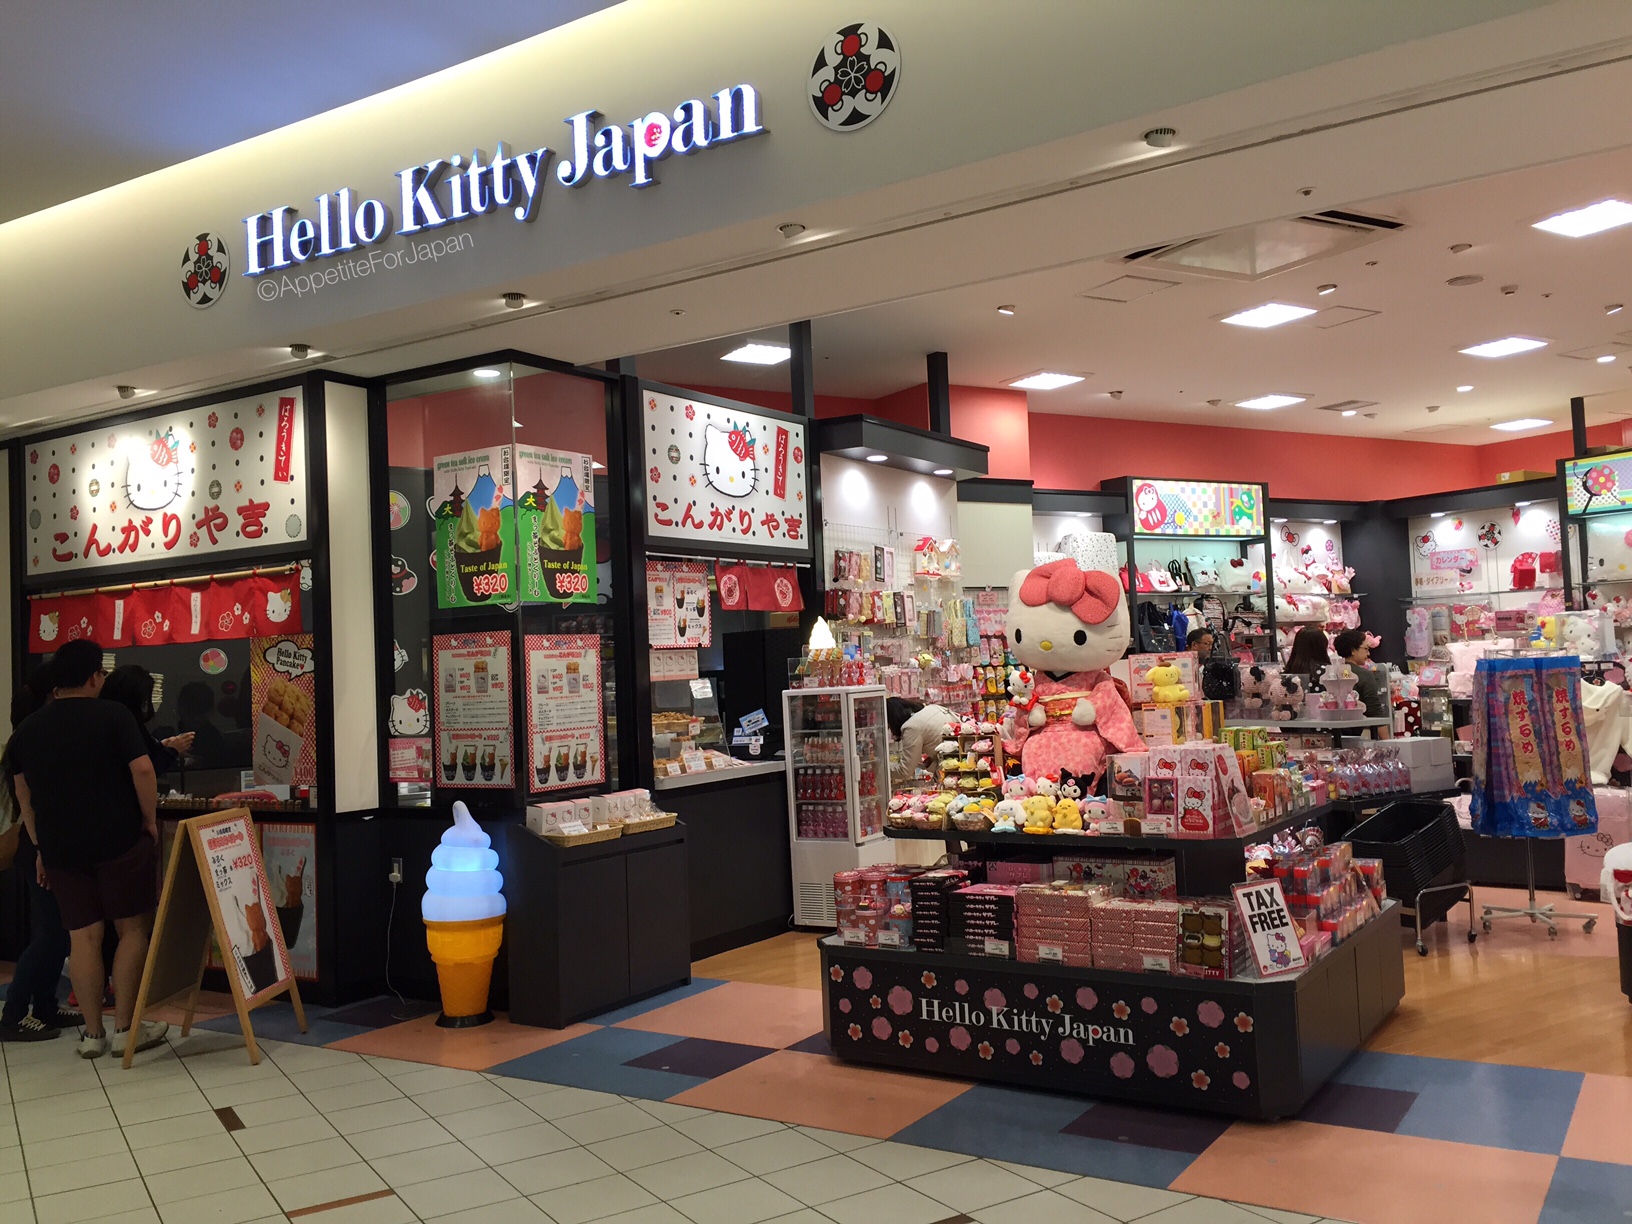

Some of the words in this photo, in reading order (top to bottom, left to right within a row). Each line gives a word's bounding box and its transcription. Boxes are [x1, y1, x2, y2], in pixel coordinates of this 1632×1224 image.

[242, 187, 390, 277] Hello
[394, 141, 554, 236] Kitty
[557, 83, 768, 189] Japan
[442, 504, 452, 516] 大
[524, 495, 535, 507] 大
[461, 564, 478, 573] Taste
[480, 562, 487, 571] of
[488, 562, 508, 573] Japan
[544, 560, 561, 569] Taste
[562, 560, 569, 569] of
[571, 561, 588, 572] Japan
[1436, 556, 1464, 565] カレンダー
[473, 573, 508, 596] ¥320
[556, 573, 588, 594] ¥320
[276, 656, 300, 670] Pancake
[277, 647, 292, 659] Hello
[293, 650, 308, 664] Kitty
[1512, 690, 1534, 754] 焼するめ
[1555, 687, 1576, 752] 焼するめ
[232, 854, 253, 870] ¥320
[1242, 887, 1280, 912] TAX
[1248, 908, 1289, 934] FREE
[918, 997, 985, 1026] Hello
[989, 1005, 1053, 1041] Kitty
[1057, 1013, 1136, 1047] Japan
